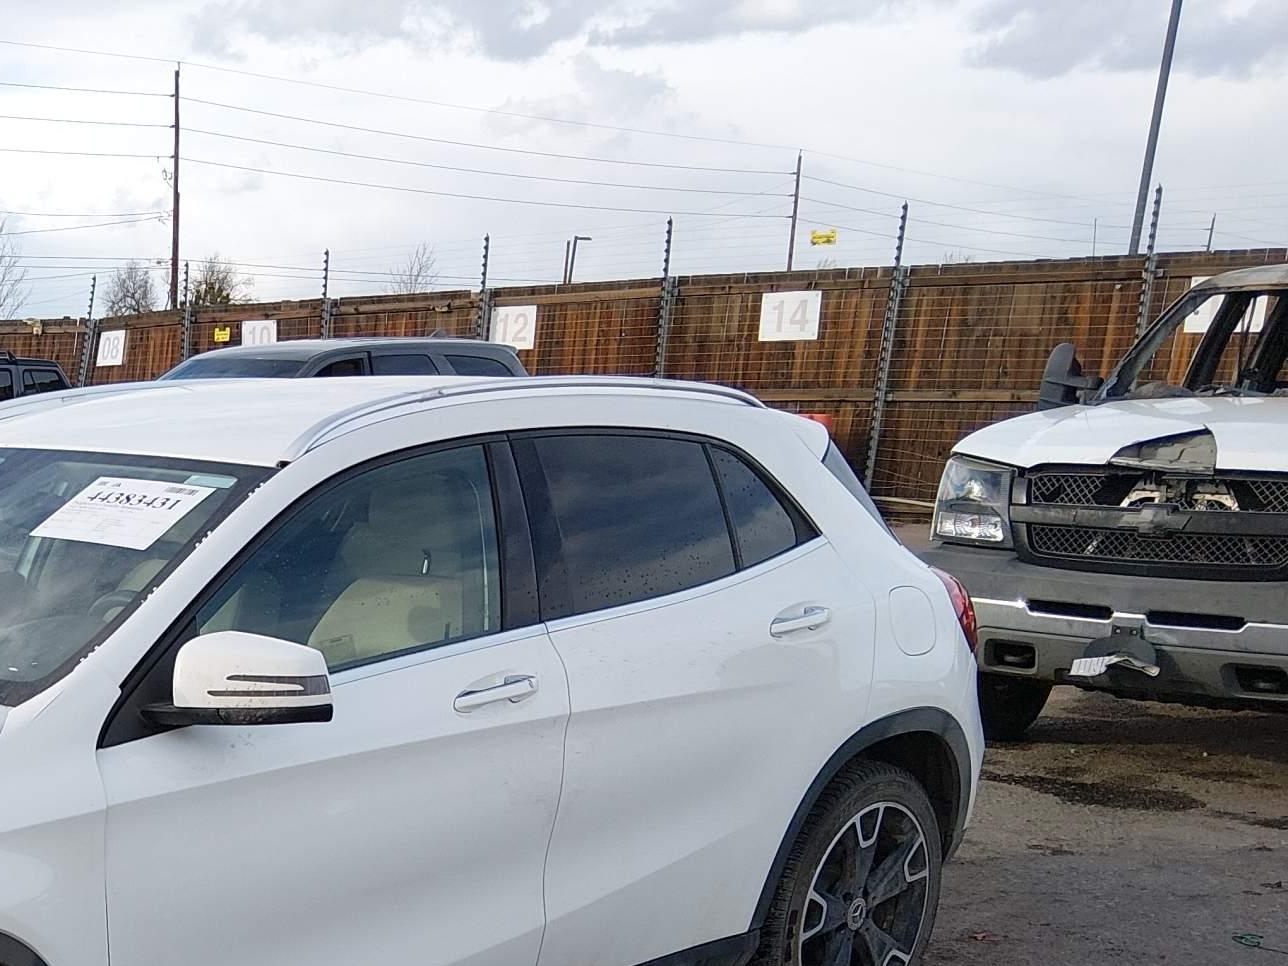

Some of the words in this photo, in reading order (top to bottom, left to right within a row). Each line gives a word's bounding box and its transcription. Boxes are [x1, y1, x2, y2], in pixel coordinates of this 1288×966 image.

[499, 312, 529, 342] 12
[772, 299, 809, 333] 14
[102, 336, 121, 360] 08
[87, 491, 182, 510] 44383431
